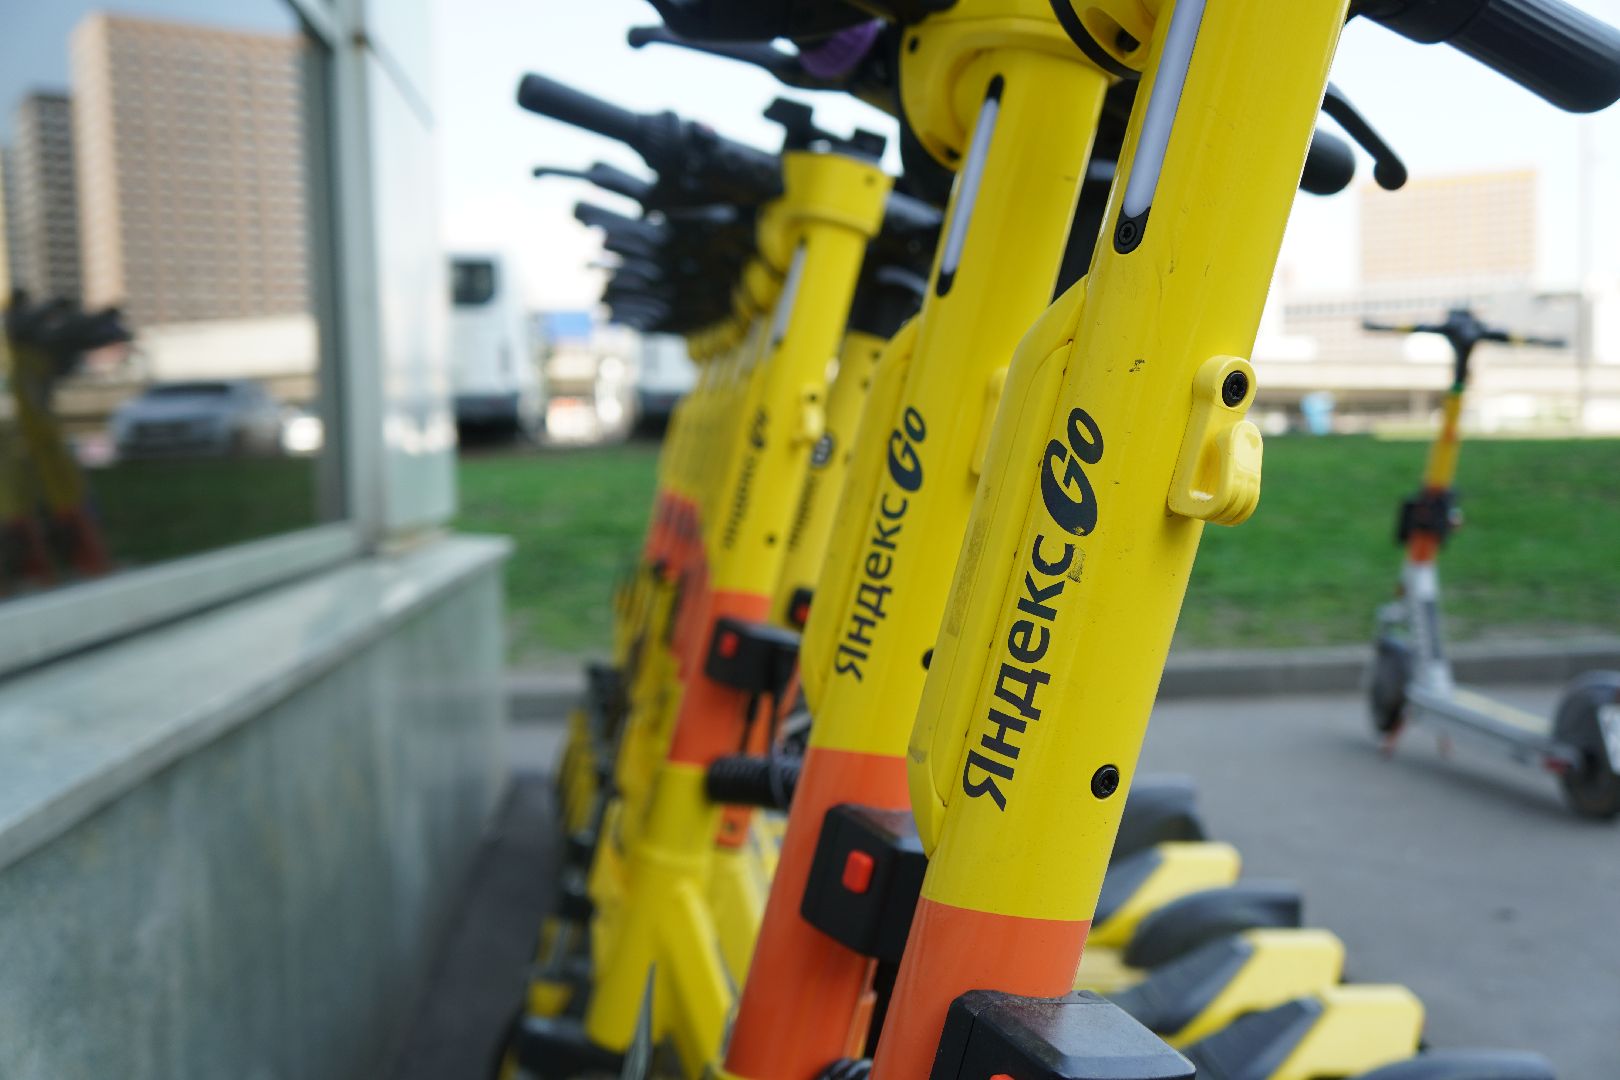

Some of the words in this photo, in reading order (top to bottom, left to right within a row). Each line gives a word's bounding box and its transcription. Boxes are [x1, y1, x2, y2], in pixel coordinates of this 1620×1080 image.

[835, 493, 908, 683] Яндекс
[887, 406, 927, 493] Go
[962, 534, 1075, 812] Яндекс
[1040, 407, 1104, 537] Go
